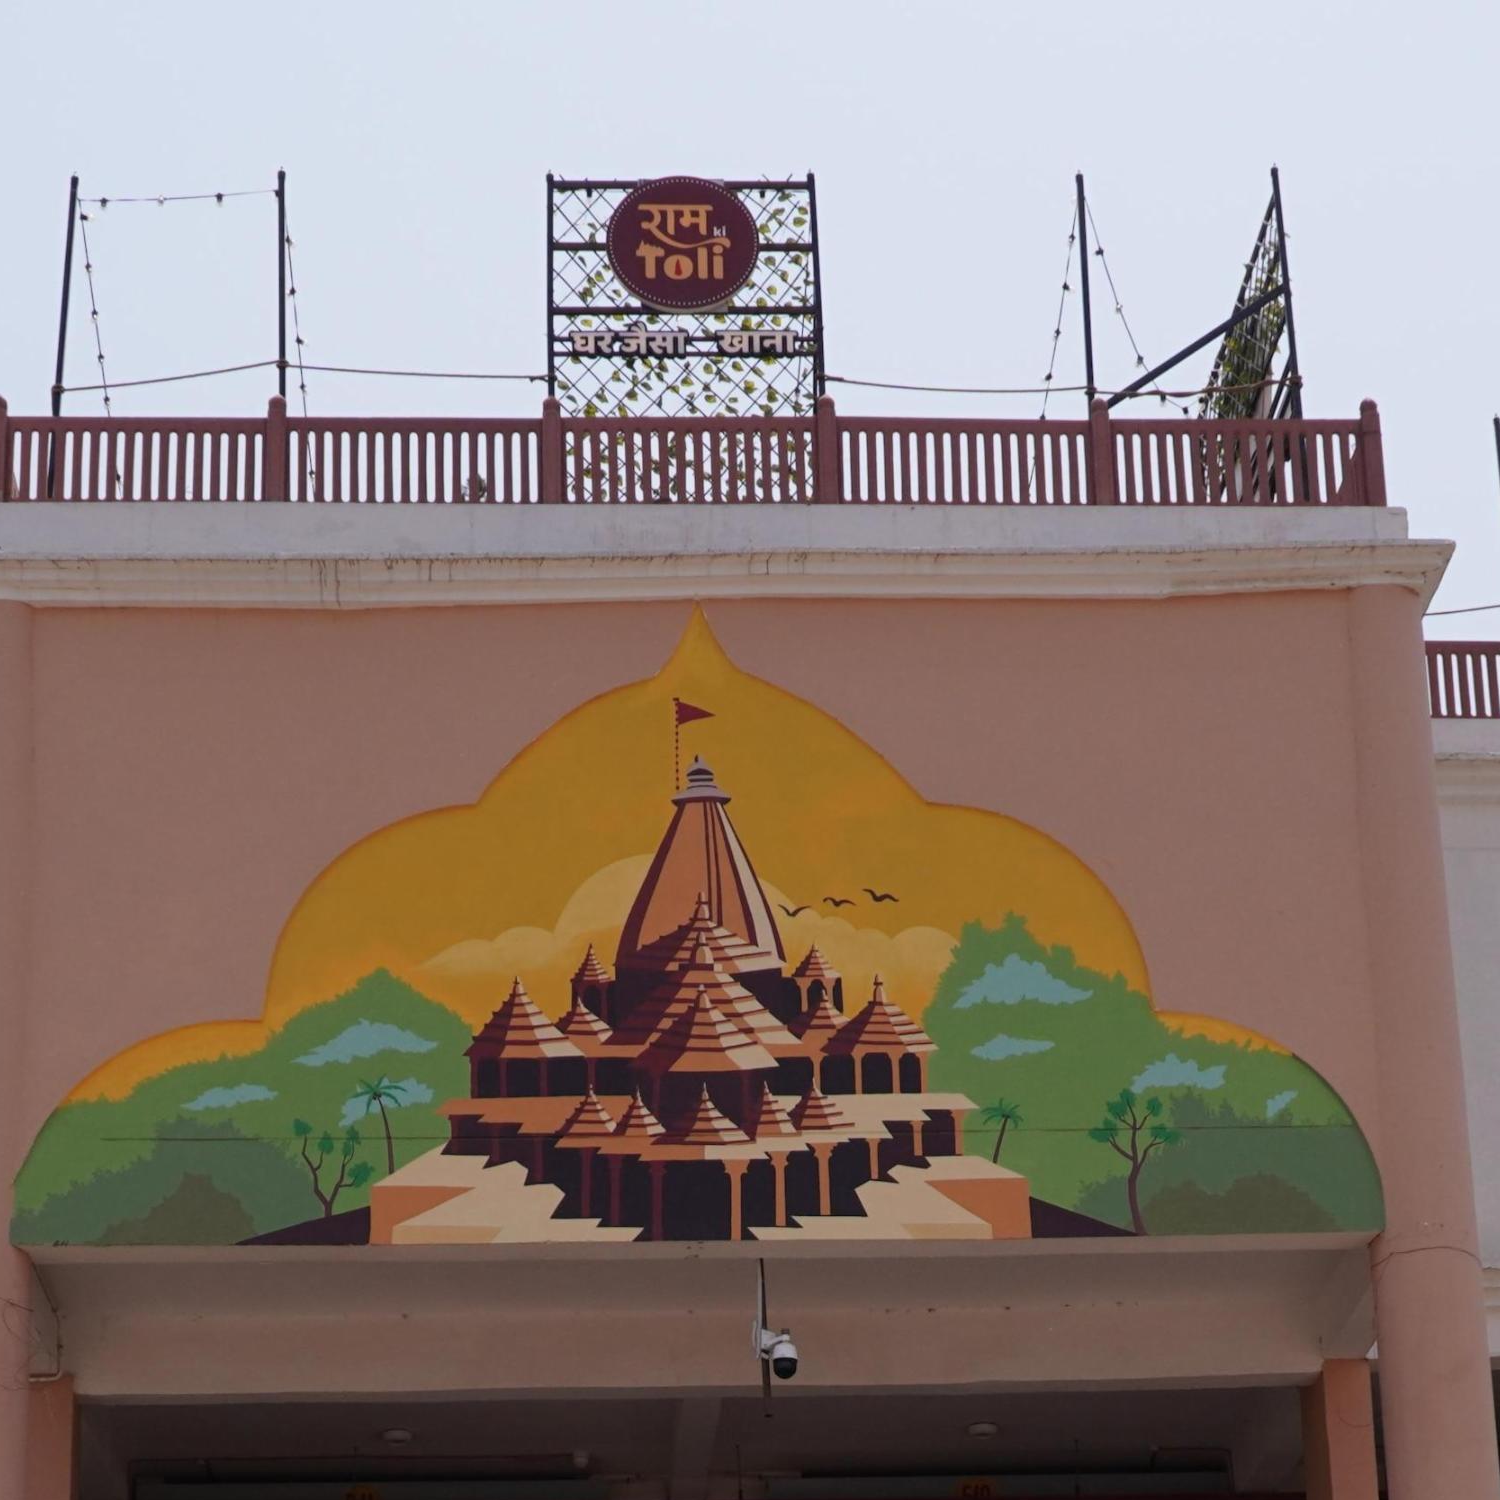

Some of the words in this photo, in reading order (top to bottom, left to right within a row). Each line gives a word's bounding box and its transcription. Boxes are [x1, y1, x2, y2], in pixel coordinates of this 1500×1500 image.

[637, 204, 731, 249] राम
[713, 225, 727, 238] ki
[636, 241, 726, 280] Toli
[570, 330, 616, 356] घर
[618, 322, 688, 356] जैसा
[715, 330, 798, 356] खाना
